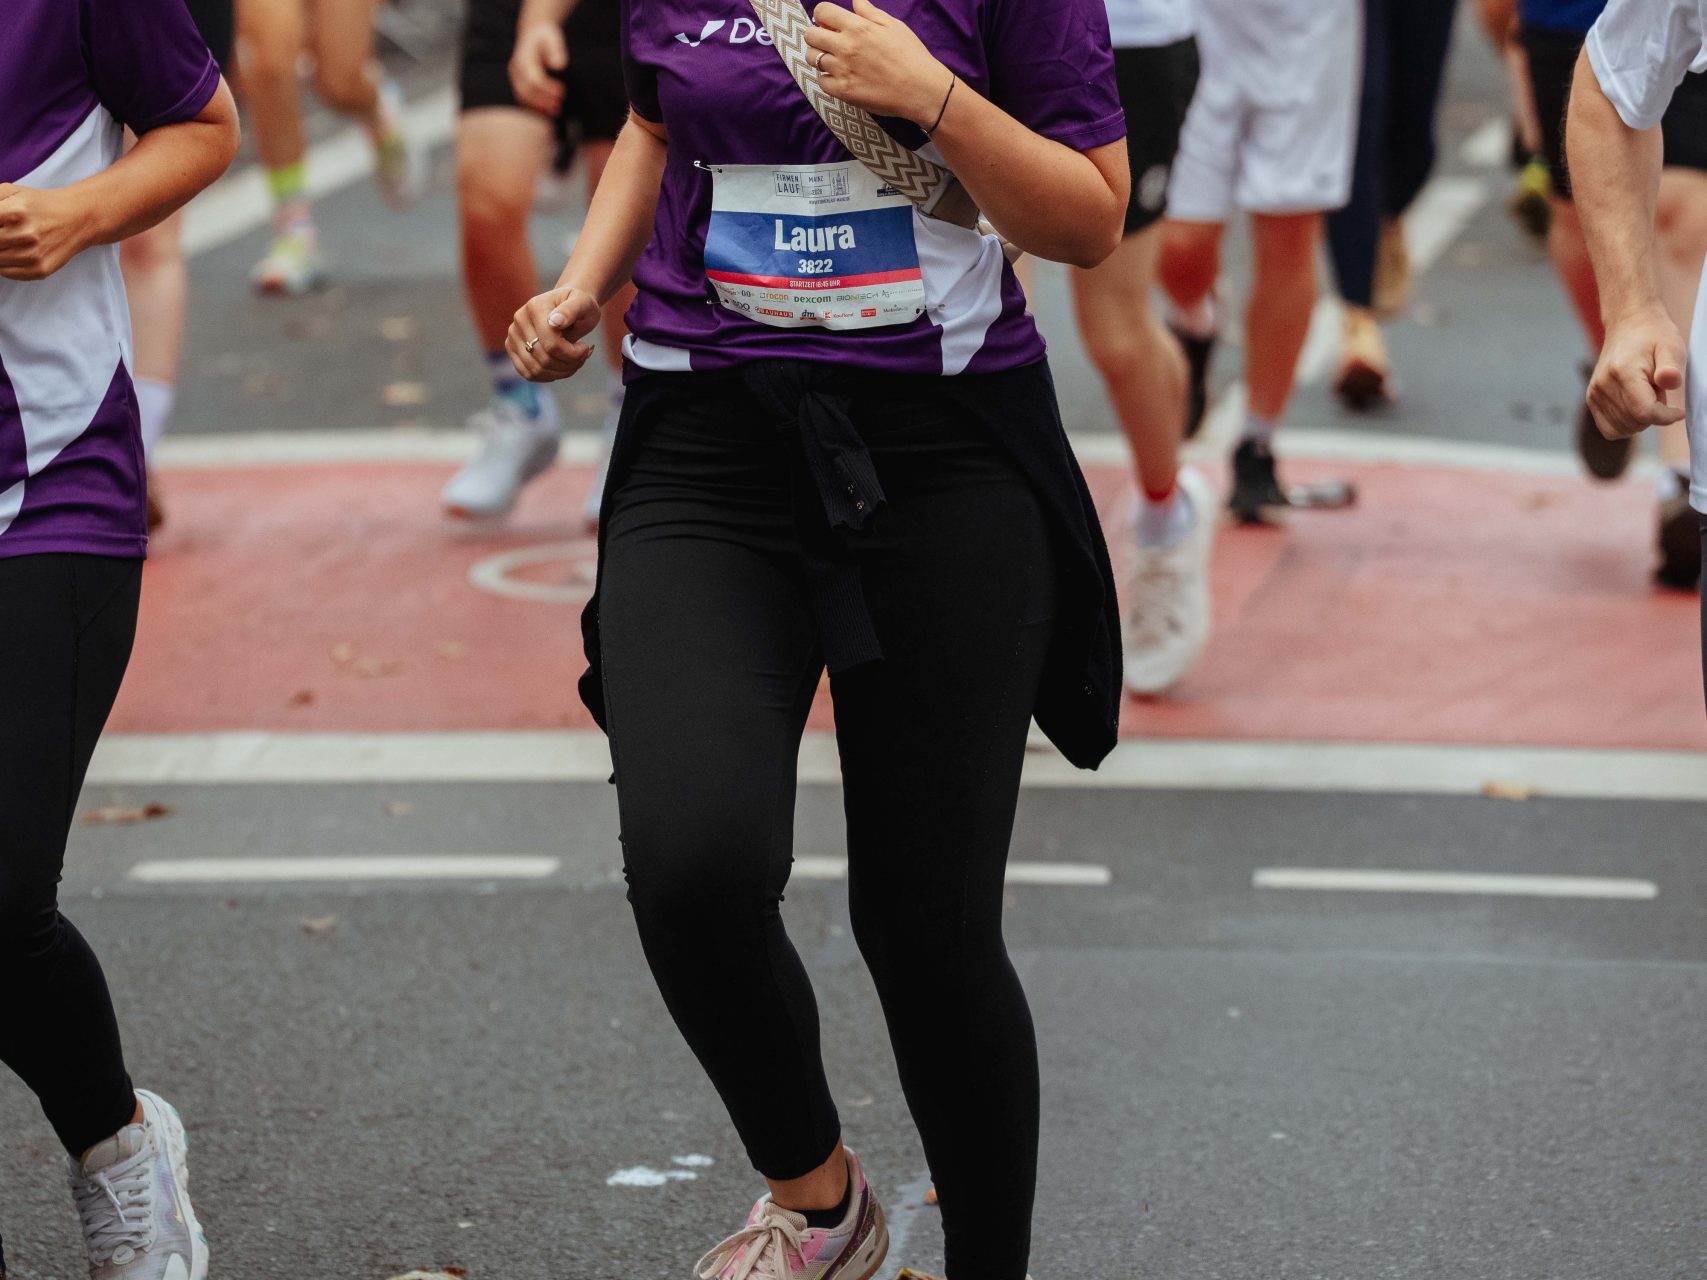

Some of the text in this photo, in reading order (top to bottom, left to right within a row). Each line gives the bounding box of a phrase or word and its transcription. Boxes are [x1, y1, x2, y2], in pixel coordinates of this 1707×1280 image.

[776, 173, 799, 182] FIRMEN
[777, 184, 800, 194] LAUF
[774, 219, 856, 252] Laura
[797, 258, 833, 274] 3822
[790, 280, 815, 288] STARTZEIT
[761, 308, 793, 317] BAUHAUS
[801, 308, 815, 317] dm
